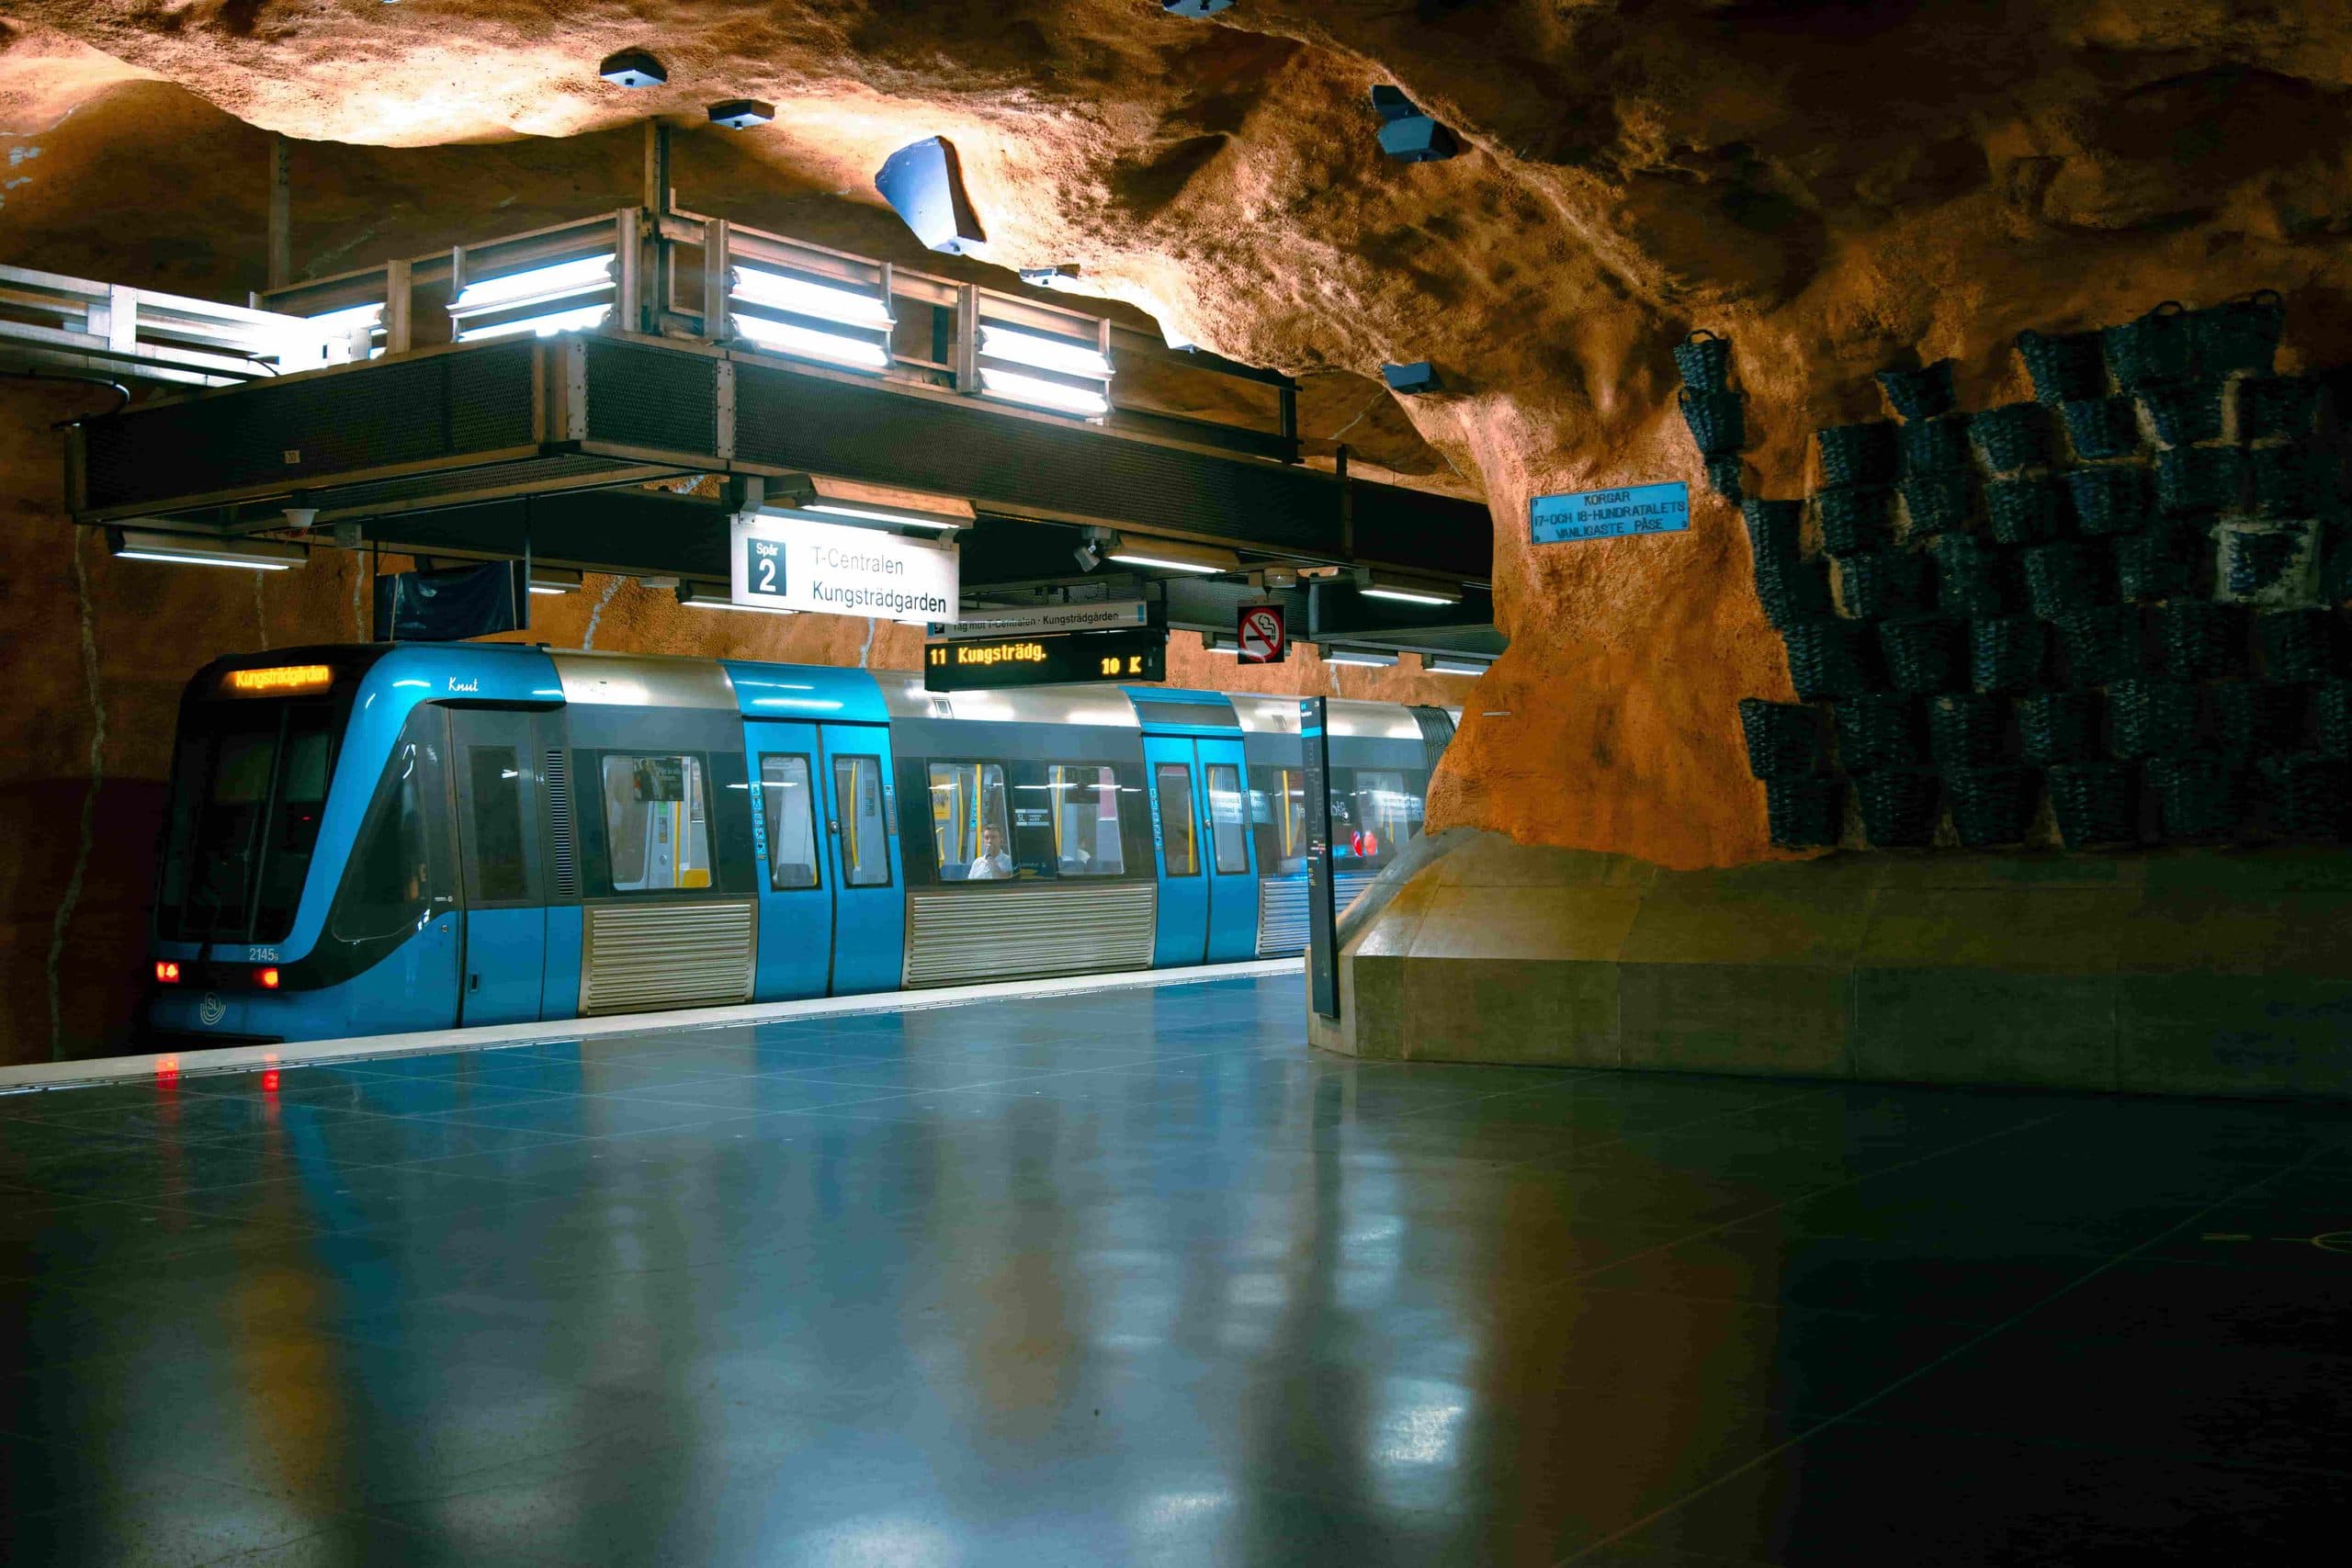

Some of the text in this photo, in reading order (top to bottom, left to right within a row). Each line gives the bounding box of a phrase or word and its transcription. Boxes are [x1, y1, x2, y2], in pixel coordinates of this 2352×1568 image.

[1583, 491, 1631, 507] KORGAR
[1555, 516, 1664, 539] VANLIGASTE PÅSE
[810, 546, 904, 576] T-Centralen
[759, 558, 776, 592] 2
[930, 648, 946, 664] 11
[958, 643, 1046, 665] Kungsträdg.
[1101, 658, 1120, 674] 10
[448, 676, 479, 692] Knut
[249, 947, 275, 962] 2145
